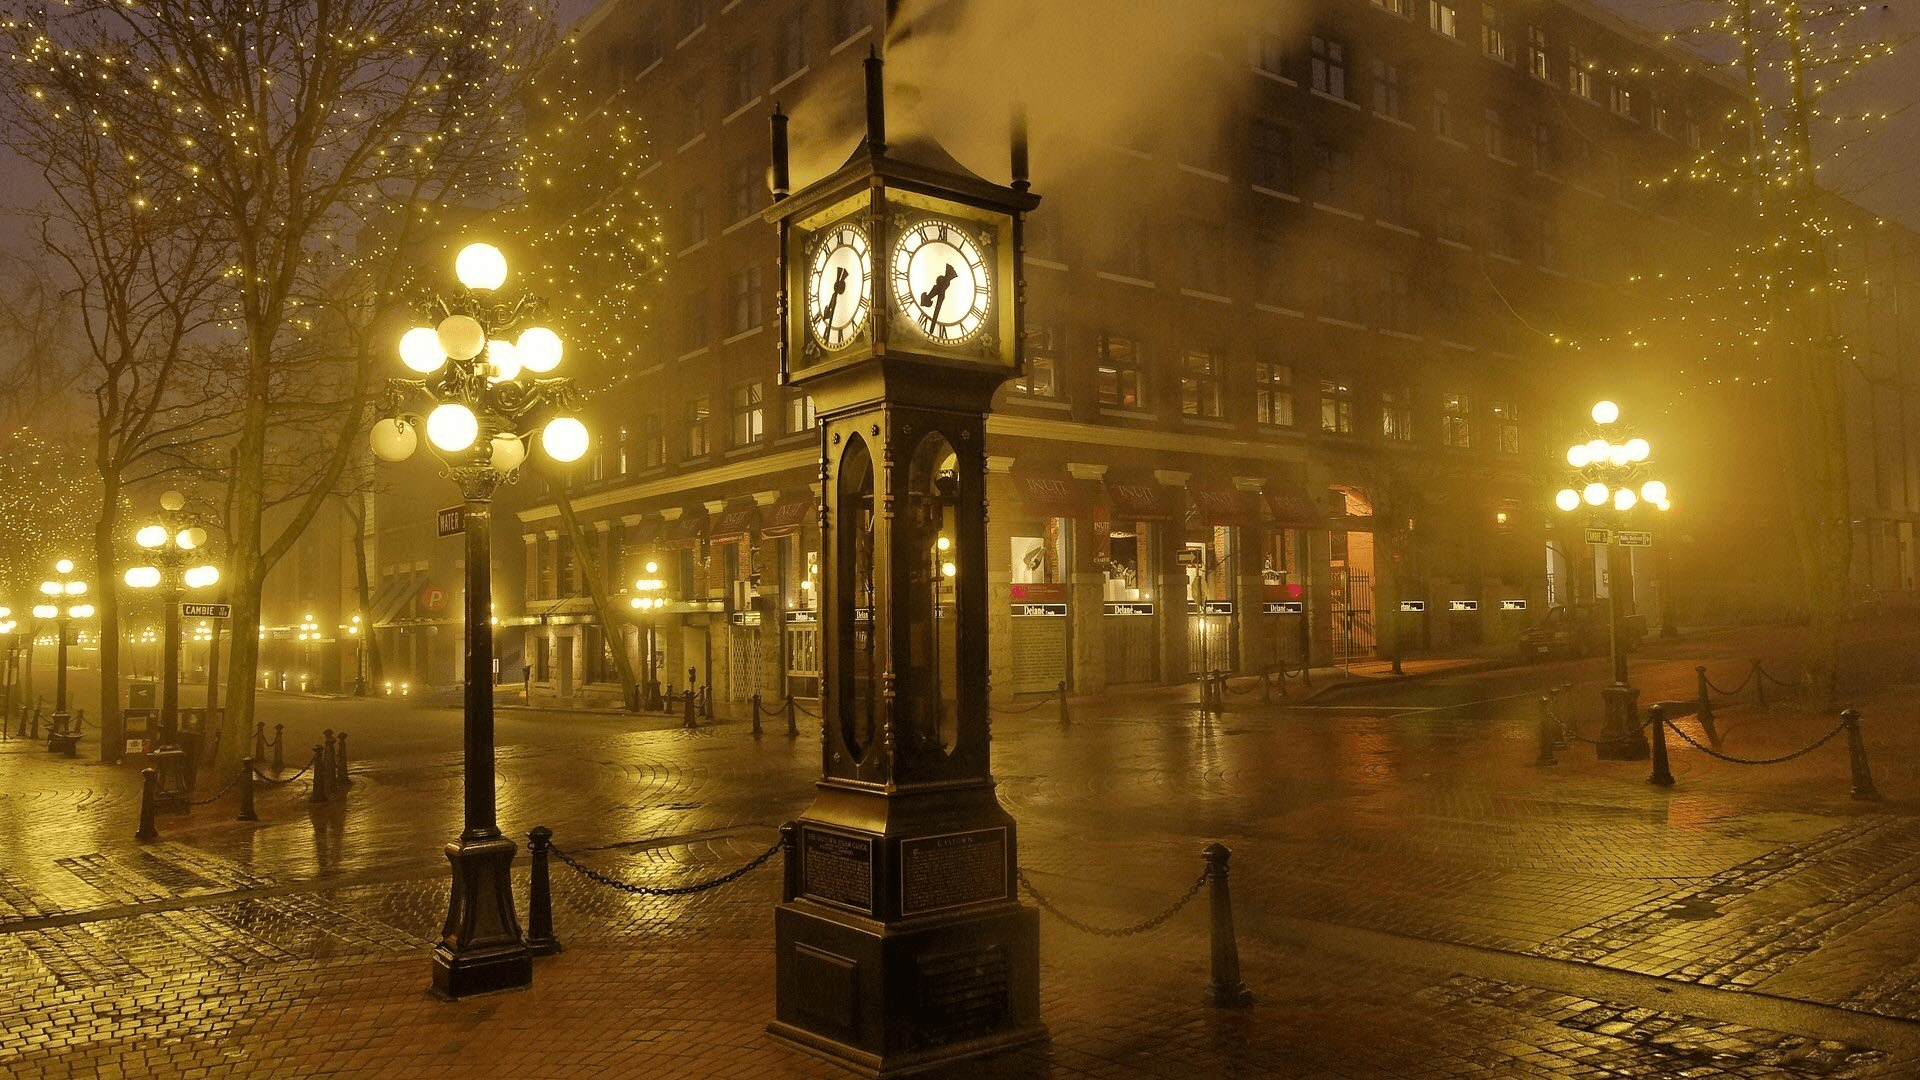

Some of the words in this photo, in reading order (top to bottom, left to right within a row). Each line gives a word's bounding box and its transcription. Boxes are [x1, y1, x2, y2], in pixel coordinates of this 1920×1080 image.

[1026, 478, 1066, 492] INUIT
[1118, 485, 1154, 499] INUIT
[440, 512, 459, 532] WATER
[428, 590, 443, 608] P
[185, 606, 215, 616] CAMBIE
